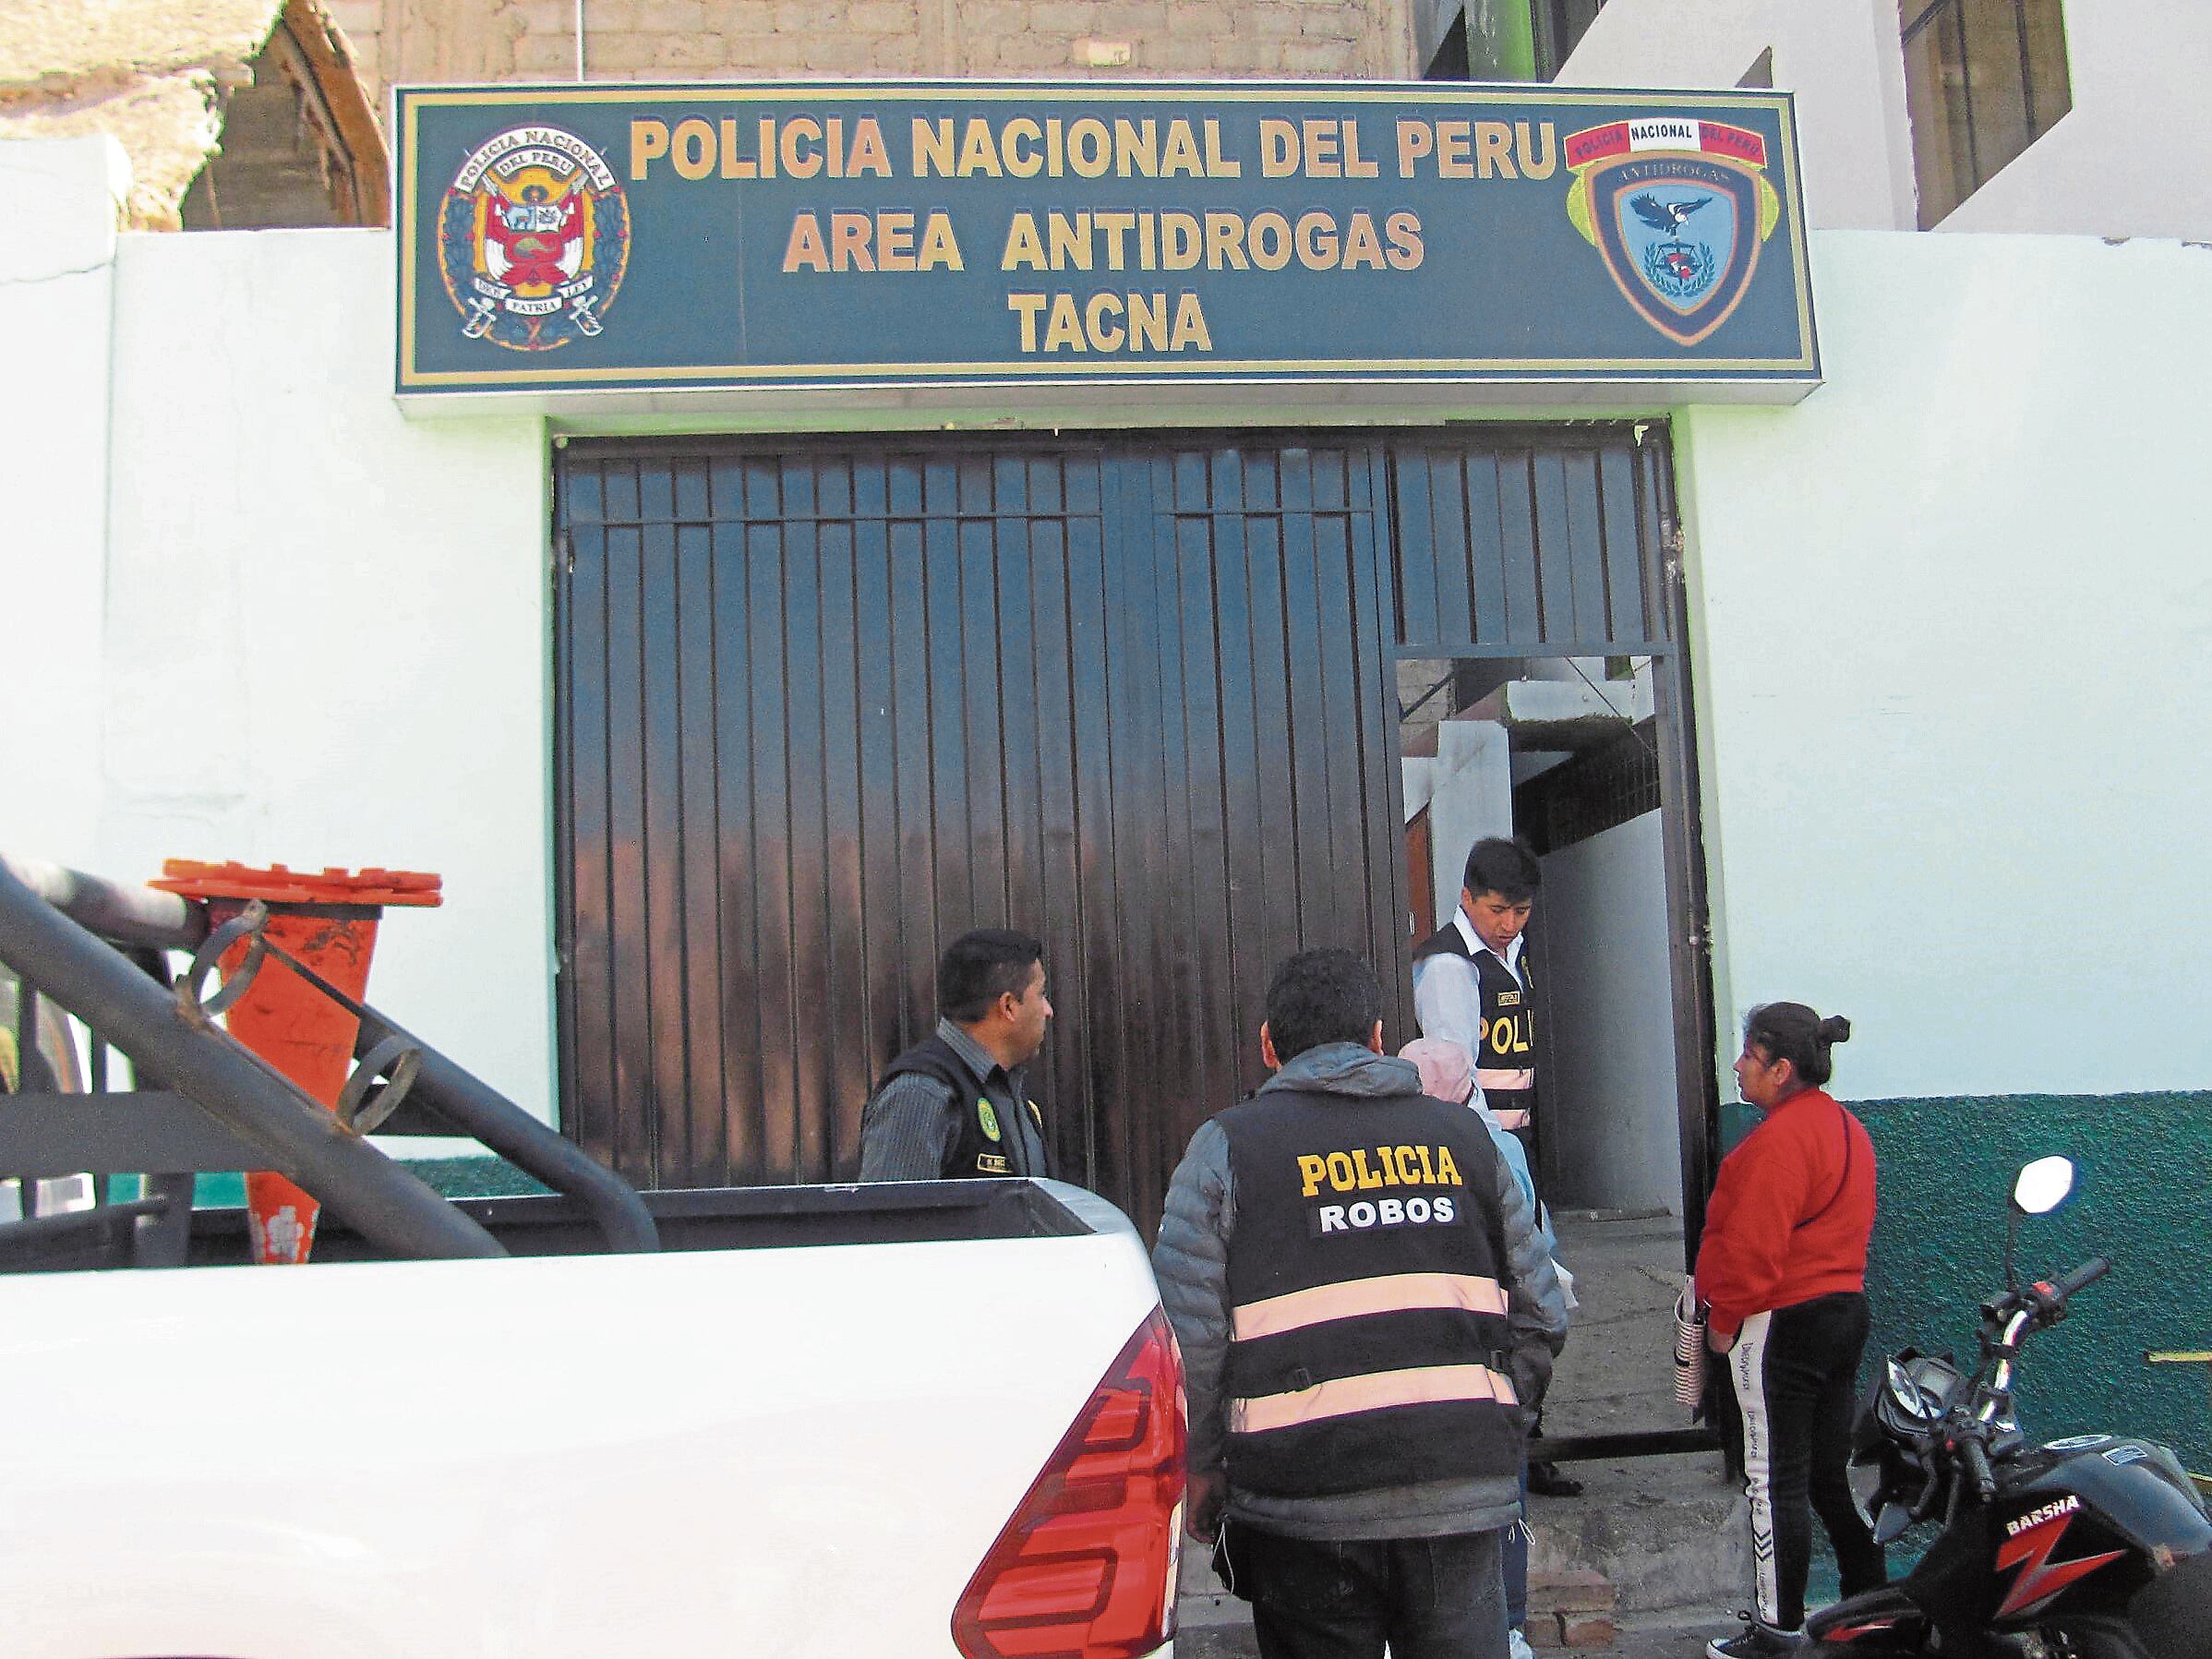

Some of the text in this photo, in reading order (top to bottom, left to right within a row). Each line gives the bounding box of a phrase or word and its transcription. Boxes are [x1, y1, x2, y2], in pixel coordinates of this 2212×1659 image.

[462, 130, 611, 186] POLICIA NACIONAL
[499, 150, 571, 173] DEL PERU
[630, 117, 1557, 180] POLICIA NACIONAL DEL PERU
[1576, 130, 1623, 158] POLICIA
[1630, 125, 1692, 140] NACIONAL
[782, 212, 1425, 272] AREA ANTIDROGAS
[511, 300, 557, 312] PATRIA
[1007, 292, 1212, 354] TACNA
[1297, 1146, 1462, 1196] POLICIA
[1319, 1197, 1455, 1232] ROBOS
[2006, 1495, 2080, 1535] BARSHA
